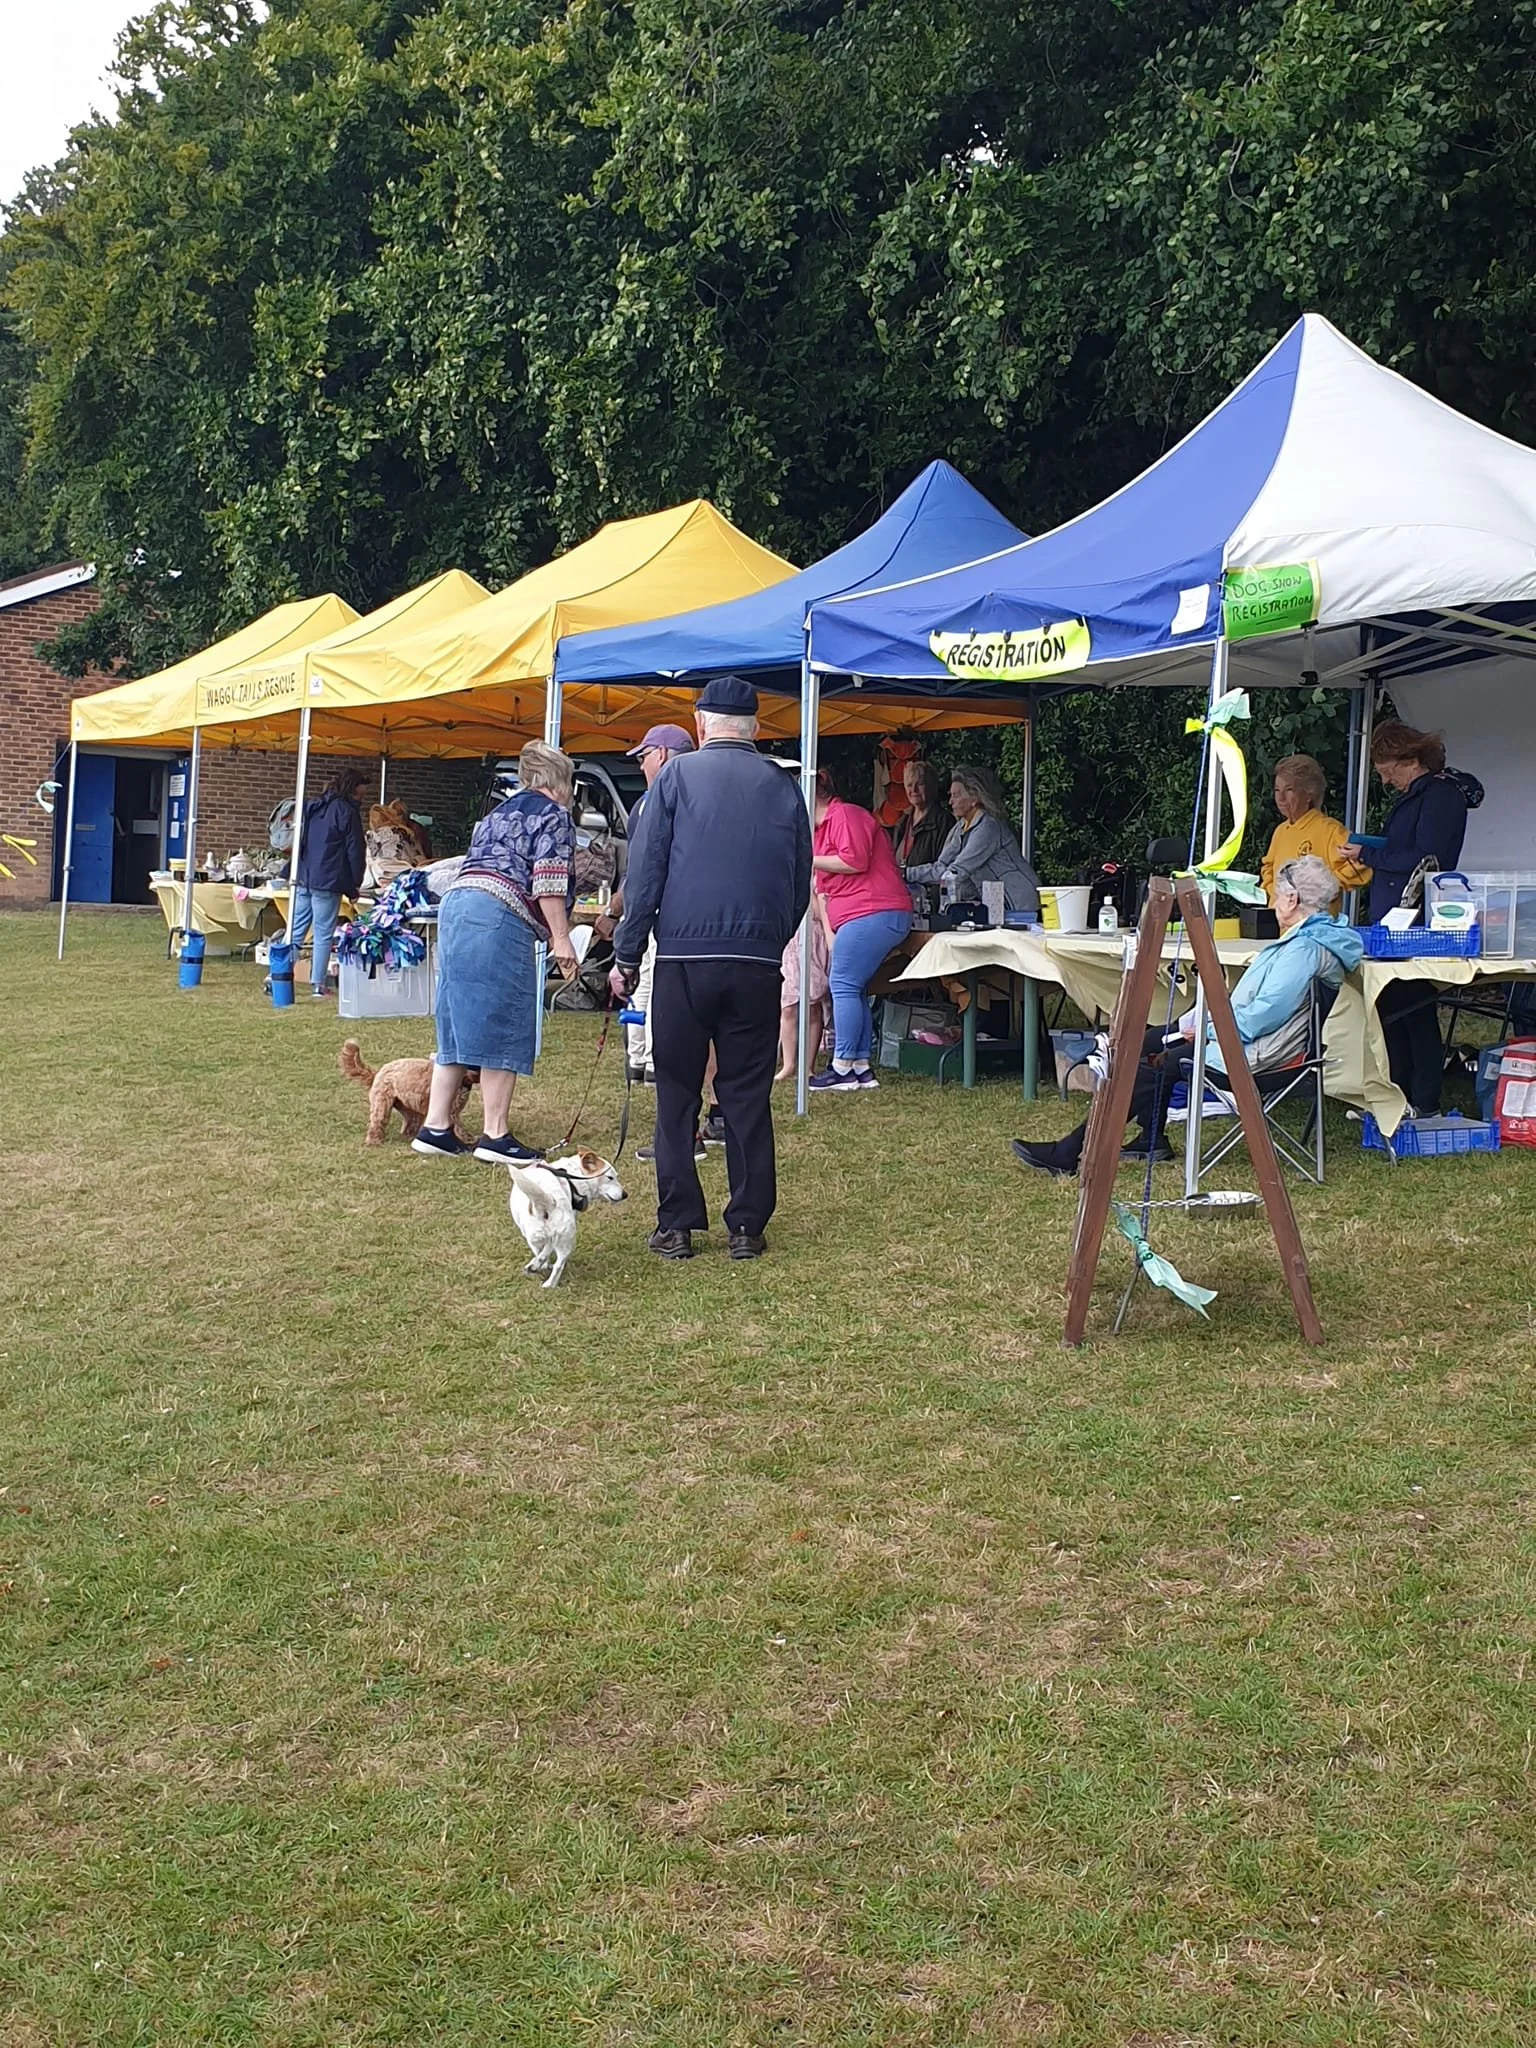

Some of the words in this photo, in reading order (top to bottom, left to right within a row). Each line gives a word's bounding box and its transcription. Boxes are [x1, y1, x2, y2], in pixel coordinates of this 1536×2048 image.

[1231, 580, 1268, 599] DOG
[1272, 575, 1302, 591] SHOW
[1232, 595, 1313, 624] REGISTRATION
[947, 635, 1067, 668] REGISTRATION
[206, 683, 238, 708] WAGGY
[239, 680, 262, 703] TAILS
[264, 672, 296, 698] RESCUE
